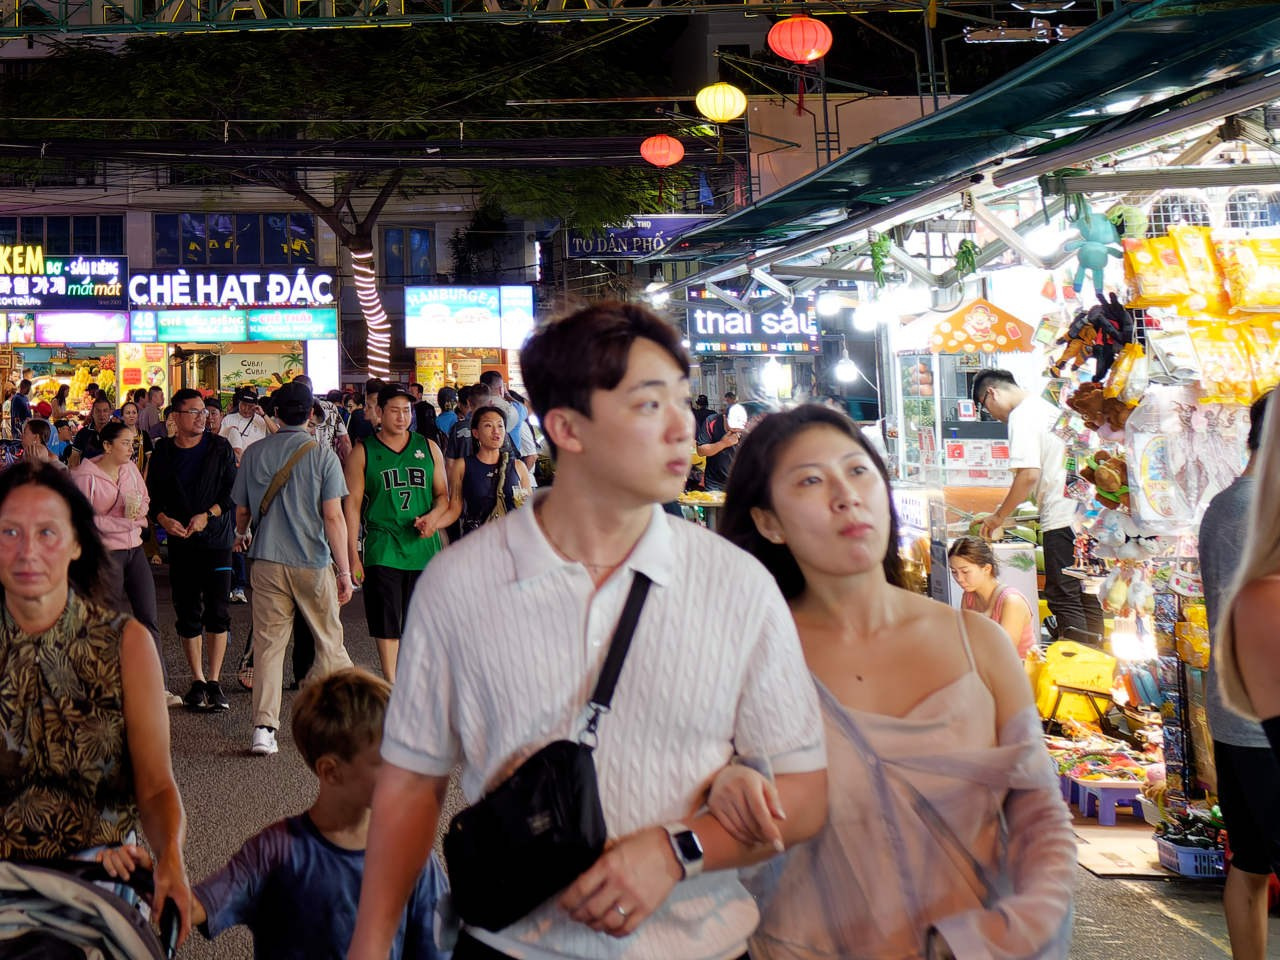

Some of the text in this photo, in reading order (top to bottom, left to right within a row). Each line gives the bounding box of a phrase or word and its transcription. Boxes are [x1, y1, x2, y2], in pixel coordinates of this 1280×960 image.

[596, 232, 628, 253] DÂN
[128, 269, 192, 304] CHÈ
[266, 267, 334, 304] ĐÁC
[407, 288, 499, 310] HAMBURGER
[133, 311, 155, 330] 48
[381, 467, 426, 490] ILB
[399, 490, 411, 511] 7
